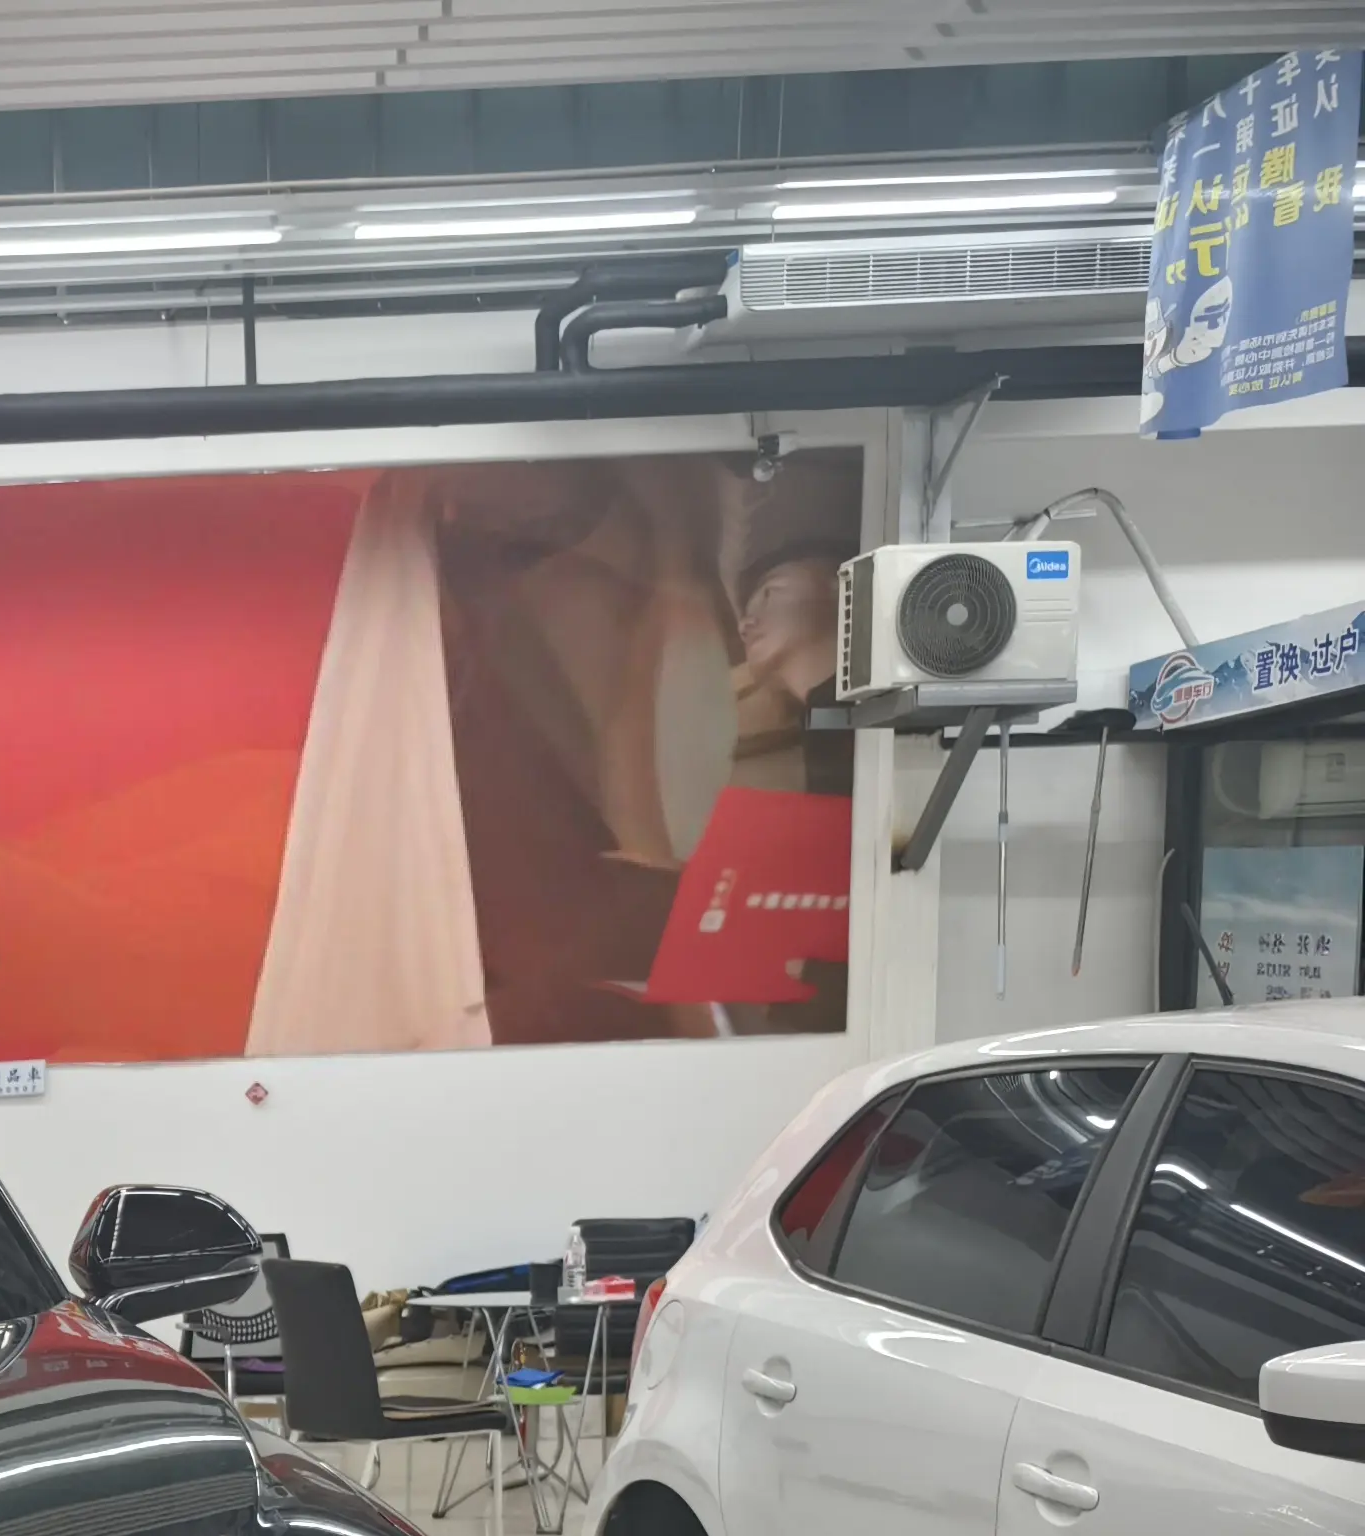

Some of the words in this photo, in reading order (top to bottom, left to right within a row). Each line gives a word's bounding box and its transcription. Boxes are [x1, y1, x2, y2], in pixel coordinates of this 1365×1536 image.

[1029, 556, 1066, 573] Midea
[1253, 643, 1300, 691] 置换
[1310, 627, 1359, 676] 过户
